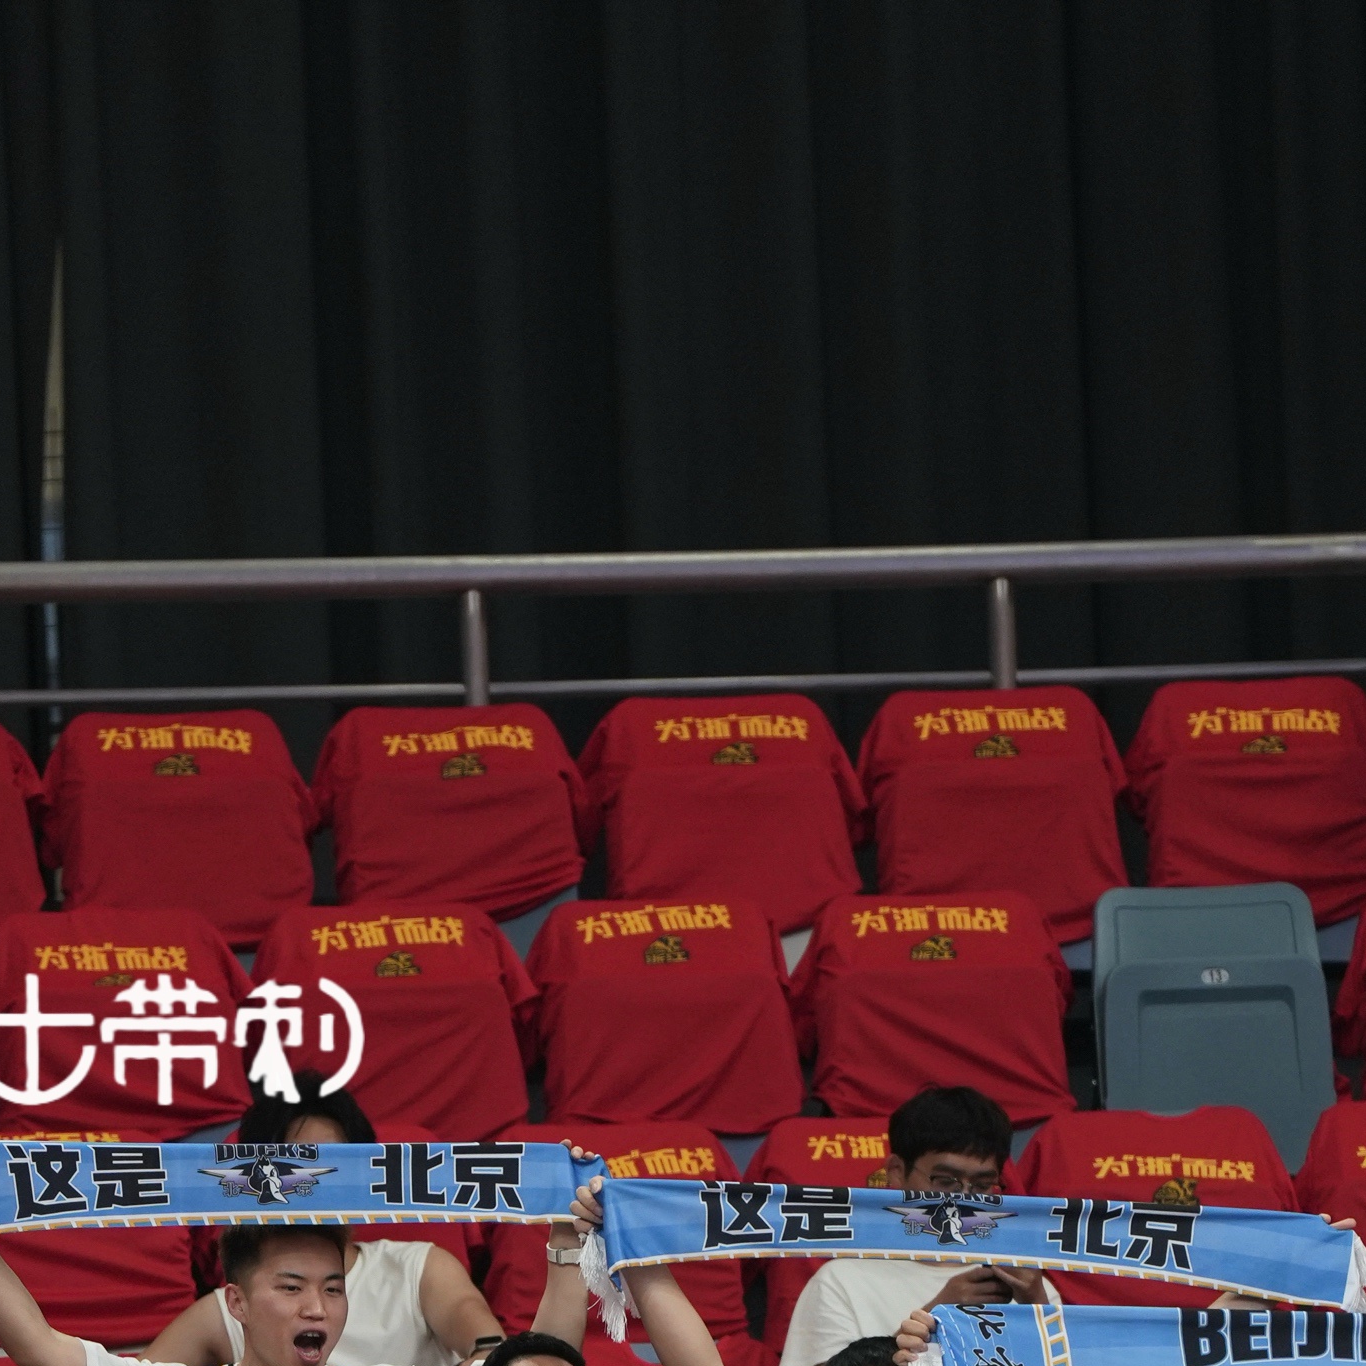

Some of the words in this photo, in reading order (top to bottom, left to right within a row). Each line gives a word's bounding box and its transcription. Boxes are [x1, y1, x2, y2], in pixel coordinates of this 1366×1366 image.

[5, 1144, 171, 1222] 这是
[370, 1142, 526, 1210] 北京
[214, 1143, 320, 1164] DUCKS
[699, 1182, 854, 1251] 这是
[1047, 1198, 1203, 1270] 北京
